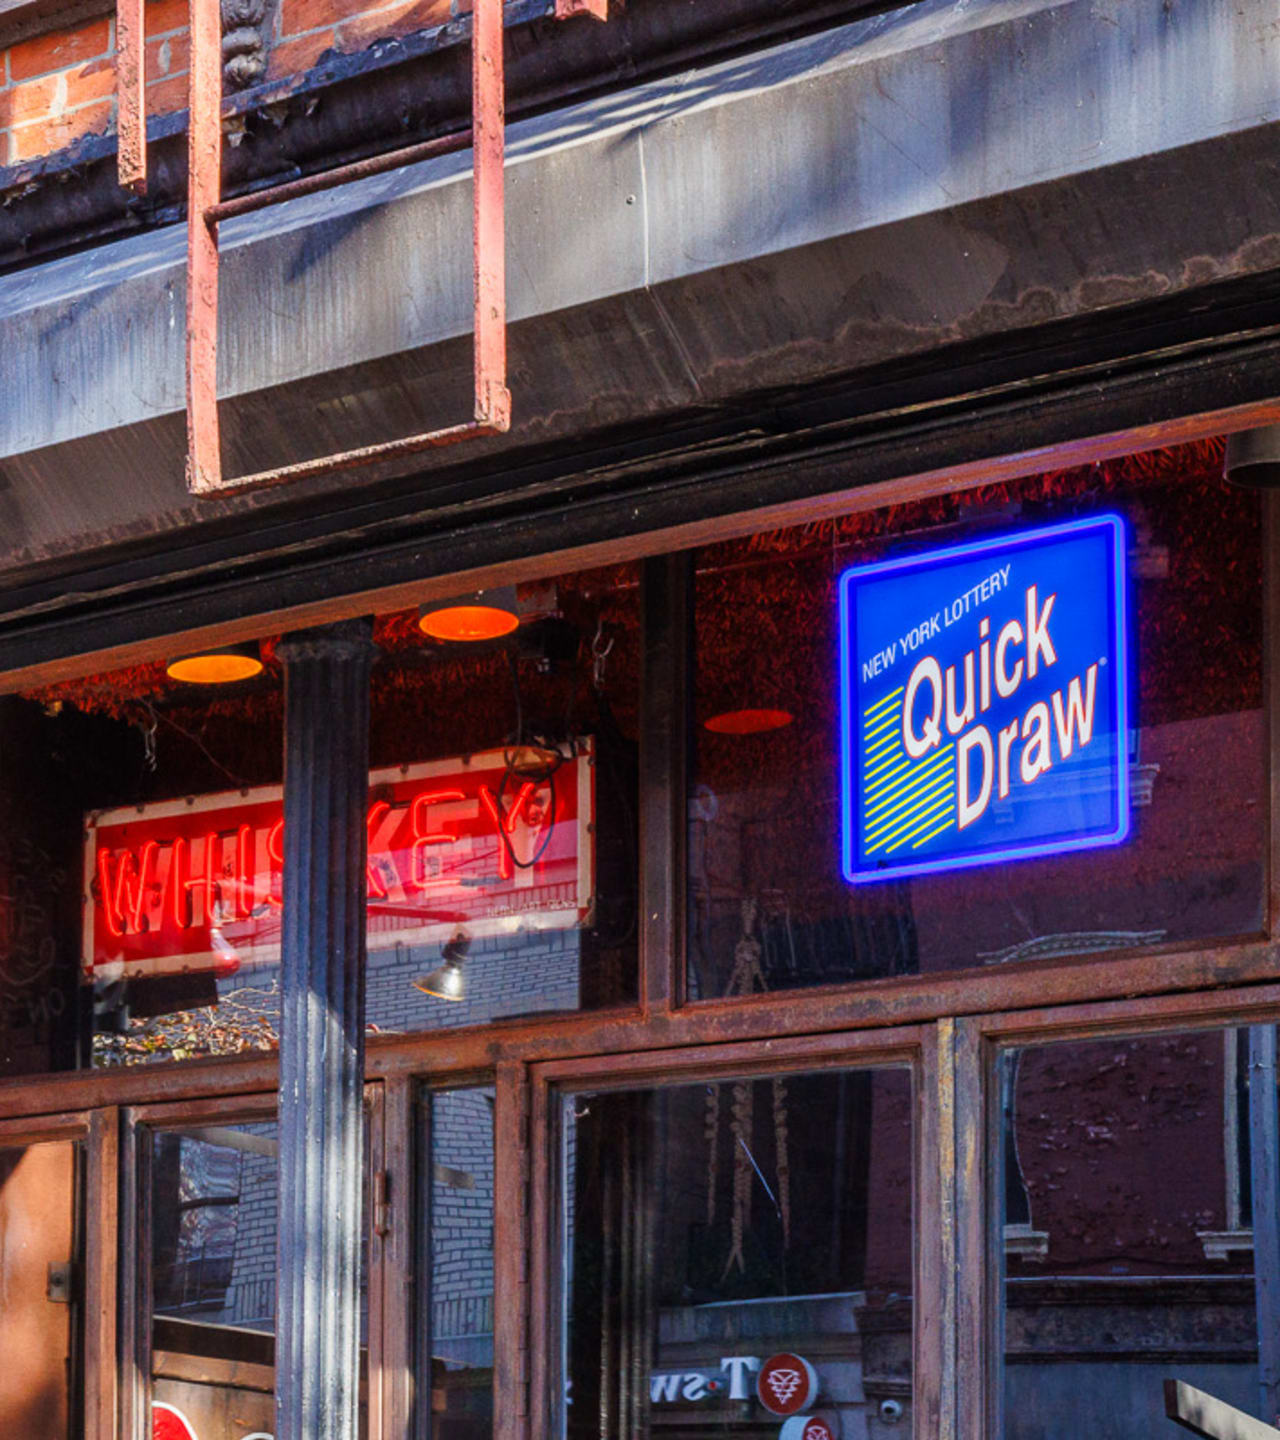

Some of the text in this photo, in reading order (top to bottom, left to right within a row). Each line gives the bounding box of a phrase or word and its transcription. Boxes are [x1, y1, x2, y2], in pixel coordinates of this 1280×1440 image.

[862, 563, 1011, 683] NEW YORK LOTTERY
[902, 583, 1057, 759] Quick
[957, 662, 1099, 831] Draw
